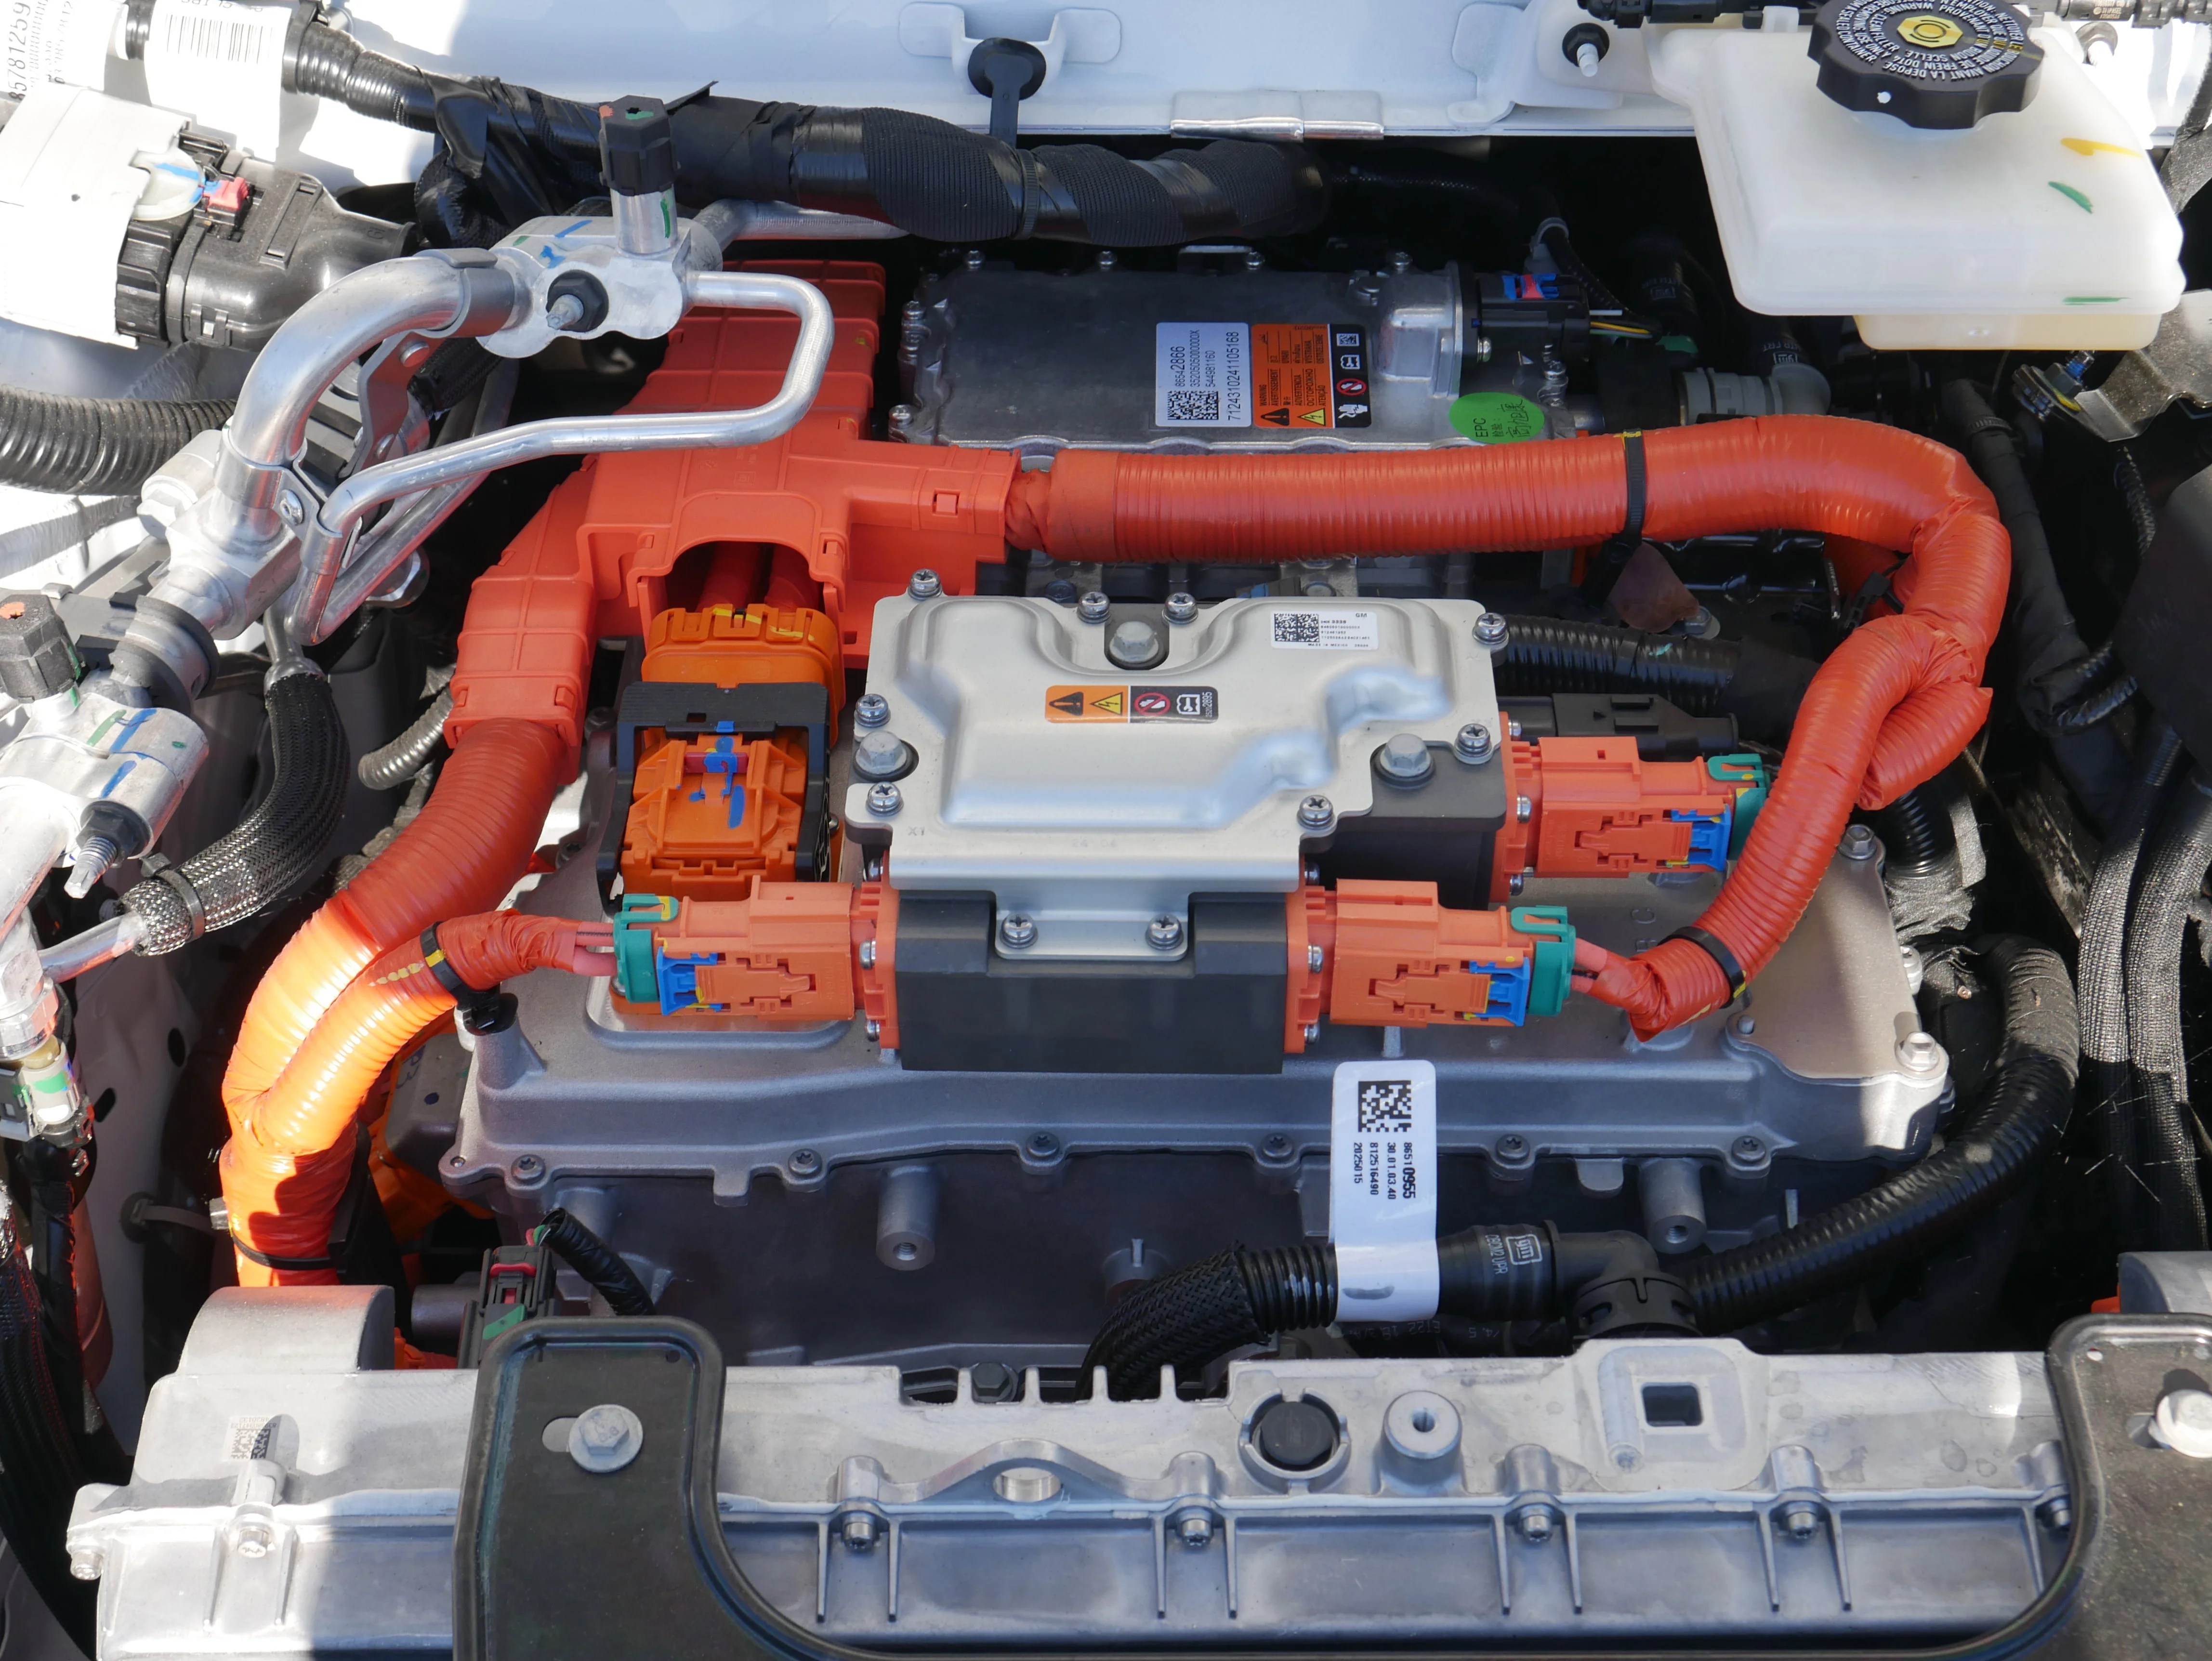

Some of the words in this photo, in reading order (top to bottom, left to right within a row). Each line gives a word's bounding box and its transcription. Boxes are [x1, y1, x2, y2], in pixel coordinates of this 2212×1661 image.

[1836, 10, 1854, 30] SEALED
[1869, 13, 1887, 32] CLEAN
[1939, 4, 1990, 33] PROVENANT
[1996, 12, 2025, 41] NETTOYER
[1990, 25, 2007, 36] QUE
[1838, 31, 1878, 65] CONTAINER.
[1855, 32, 1873, 44] USE
[1865, 43, 1892, 58] ONLY
[1871, 32, 1900, 52] FILLER
[1893, 55, 1920, 68] DOT4
[1905, 49, 1948, 62] SCELLE.
[1950, 47, 1984, 61] BIDON
[1958, 60, 1976, 69] DE
[1973, 45, 2004, 65] LIQUIDE
[1982, 49, 2020, 73] BOUCHON
[1924, 61, 1958, 70] FREIN
[1931, 70, 1946, 80] LA
[1951, 67, 1984, 81] AVANT
[1170, 346, 1185, 387] 86542866
[1205, 350, 1215, 387] 544981160
[1226, 331, 1241, 421] 7124310241105168
[1270, 369, 1279, 406] AVERTISSEMENT
[1294, 374, 1303, 406] ADVERTENCIA
[1305, 369, 1315, 406] ОСТОРОЖНО
[1473, 418, 1489, 438] EPC
[1354, 1142, 1363, 1184] 2025015
[1370, 1142, 1379, 1195] 812516490
[1387, 1142, 1396, 1200] 30.01.03.40
[1403, 1142, 1416, 1199] 86510955
[1514, 1239, 1534, 1259] gm
[1491, 1256, 1508, 1275] UPR
